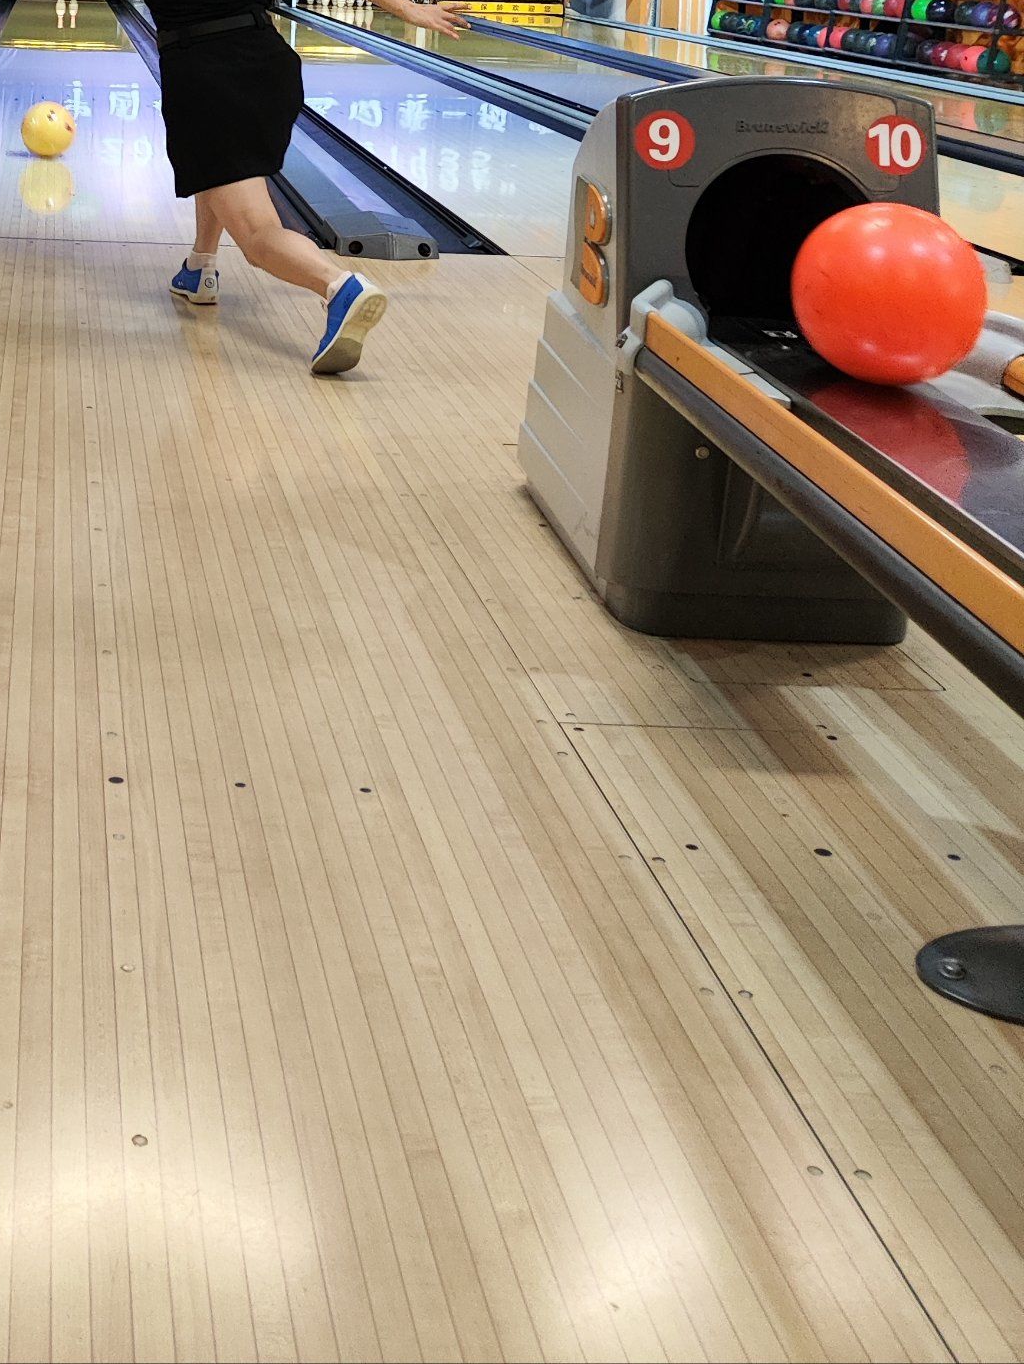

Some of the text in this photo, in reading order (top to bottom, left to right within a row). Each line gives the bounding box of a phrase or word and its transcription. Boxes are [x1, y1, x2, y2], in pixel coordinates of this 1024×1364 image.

[648, 118, 681, 162] 9
[736, 120, 829, 134] Brunswick
[868, 123, 923, 168] 10
